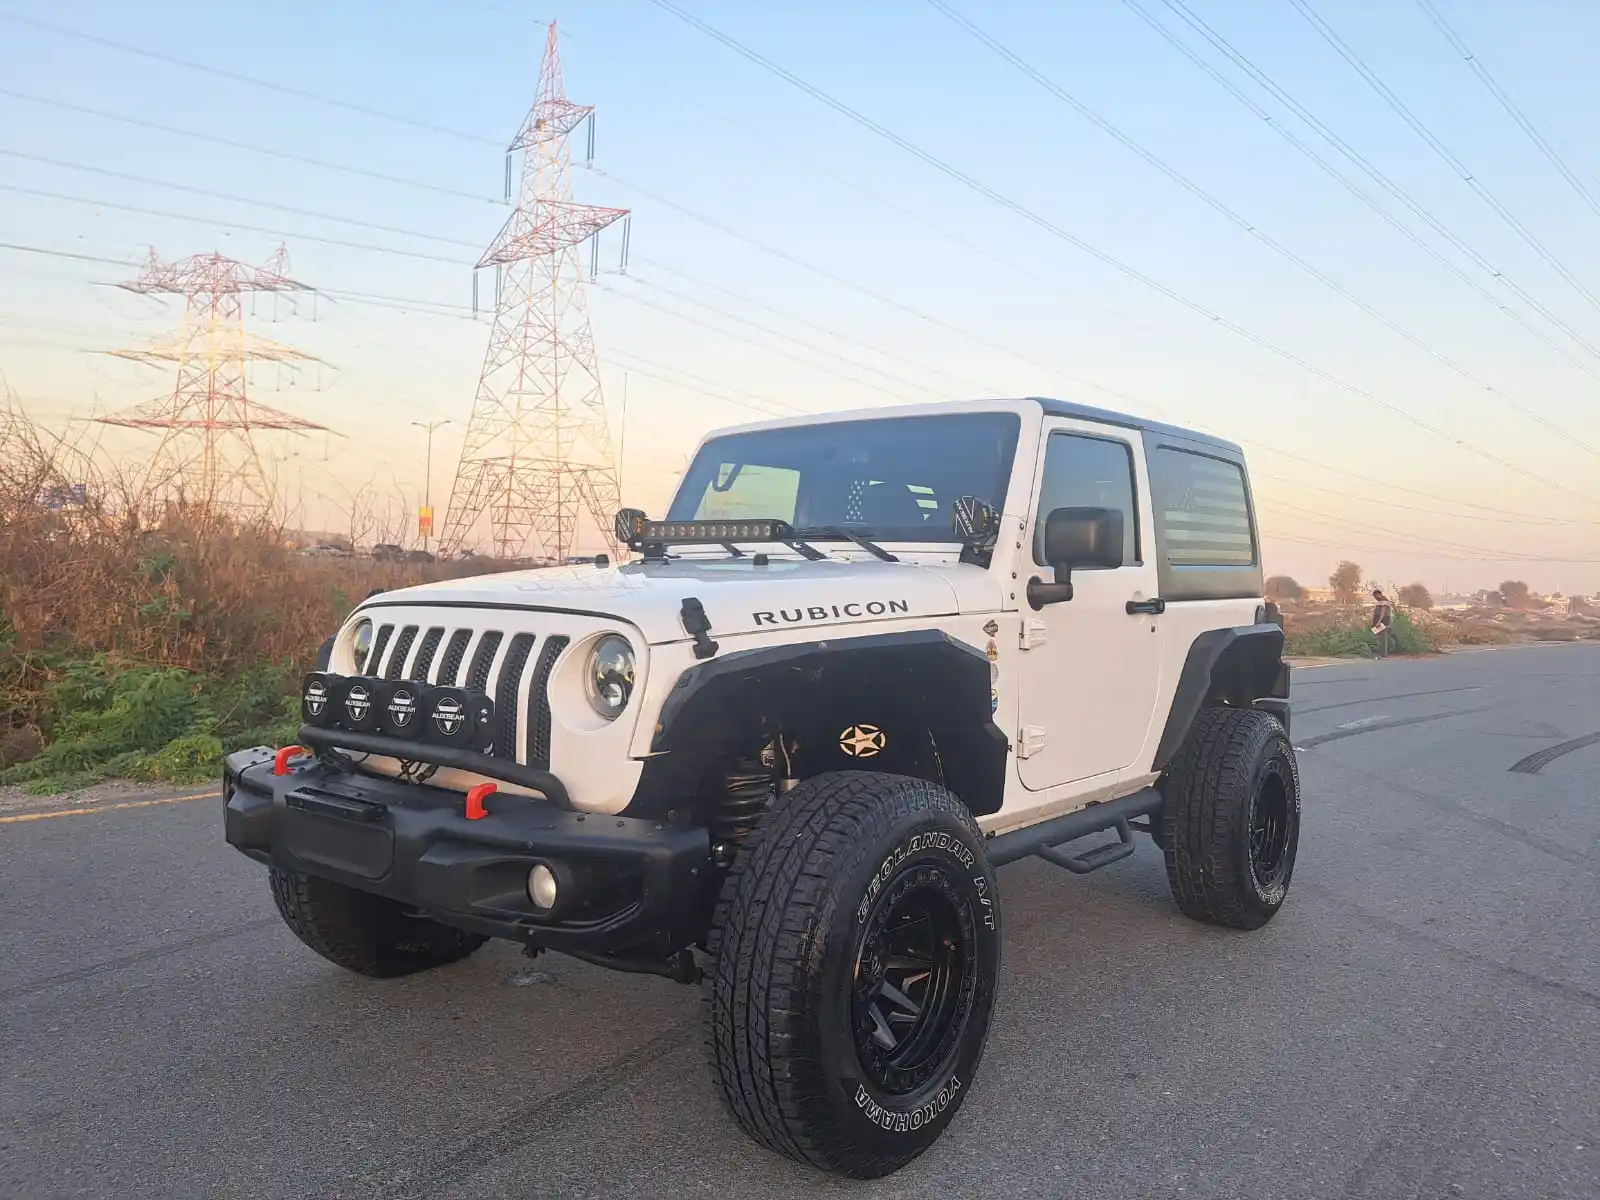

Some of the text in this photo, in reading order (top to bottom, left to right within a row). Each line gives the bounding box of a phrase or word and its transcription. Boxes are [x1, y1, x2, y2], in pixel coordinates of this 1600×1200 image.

[752, 599, 909, 625] RUBICON
[345, 699, 371, 708] AUXBEAM
[388, 704, 416, 713] AUXBEAM
[431, 712, 465, 721] AUXBEAM
[857, 831, 995, 931] GEOLANDAR A/T
[854, 1075, 961, 1133] YOKOHAMA
